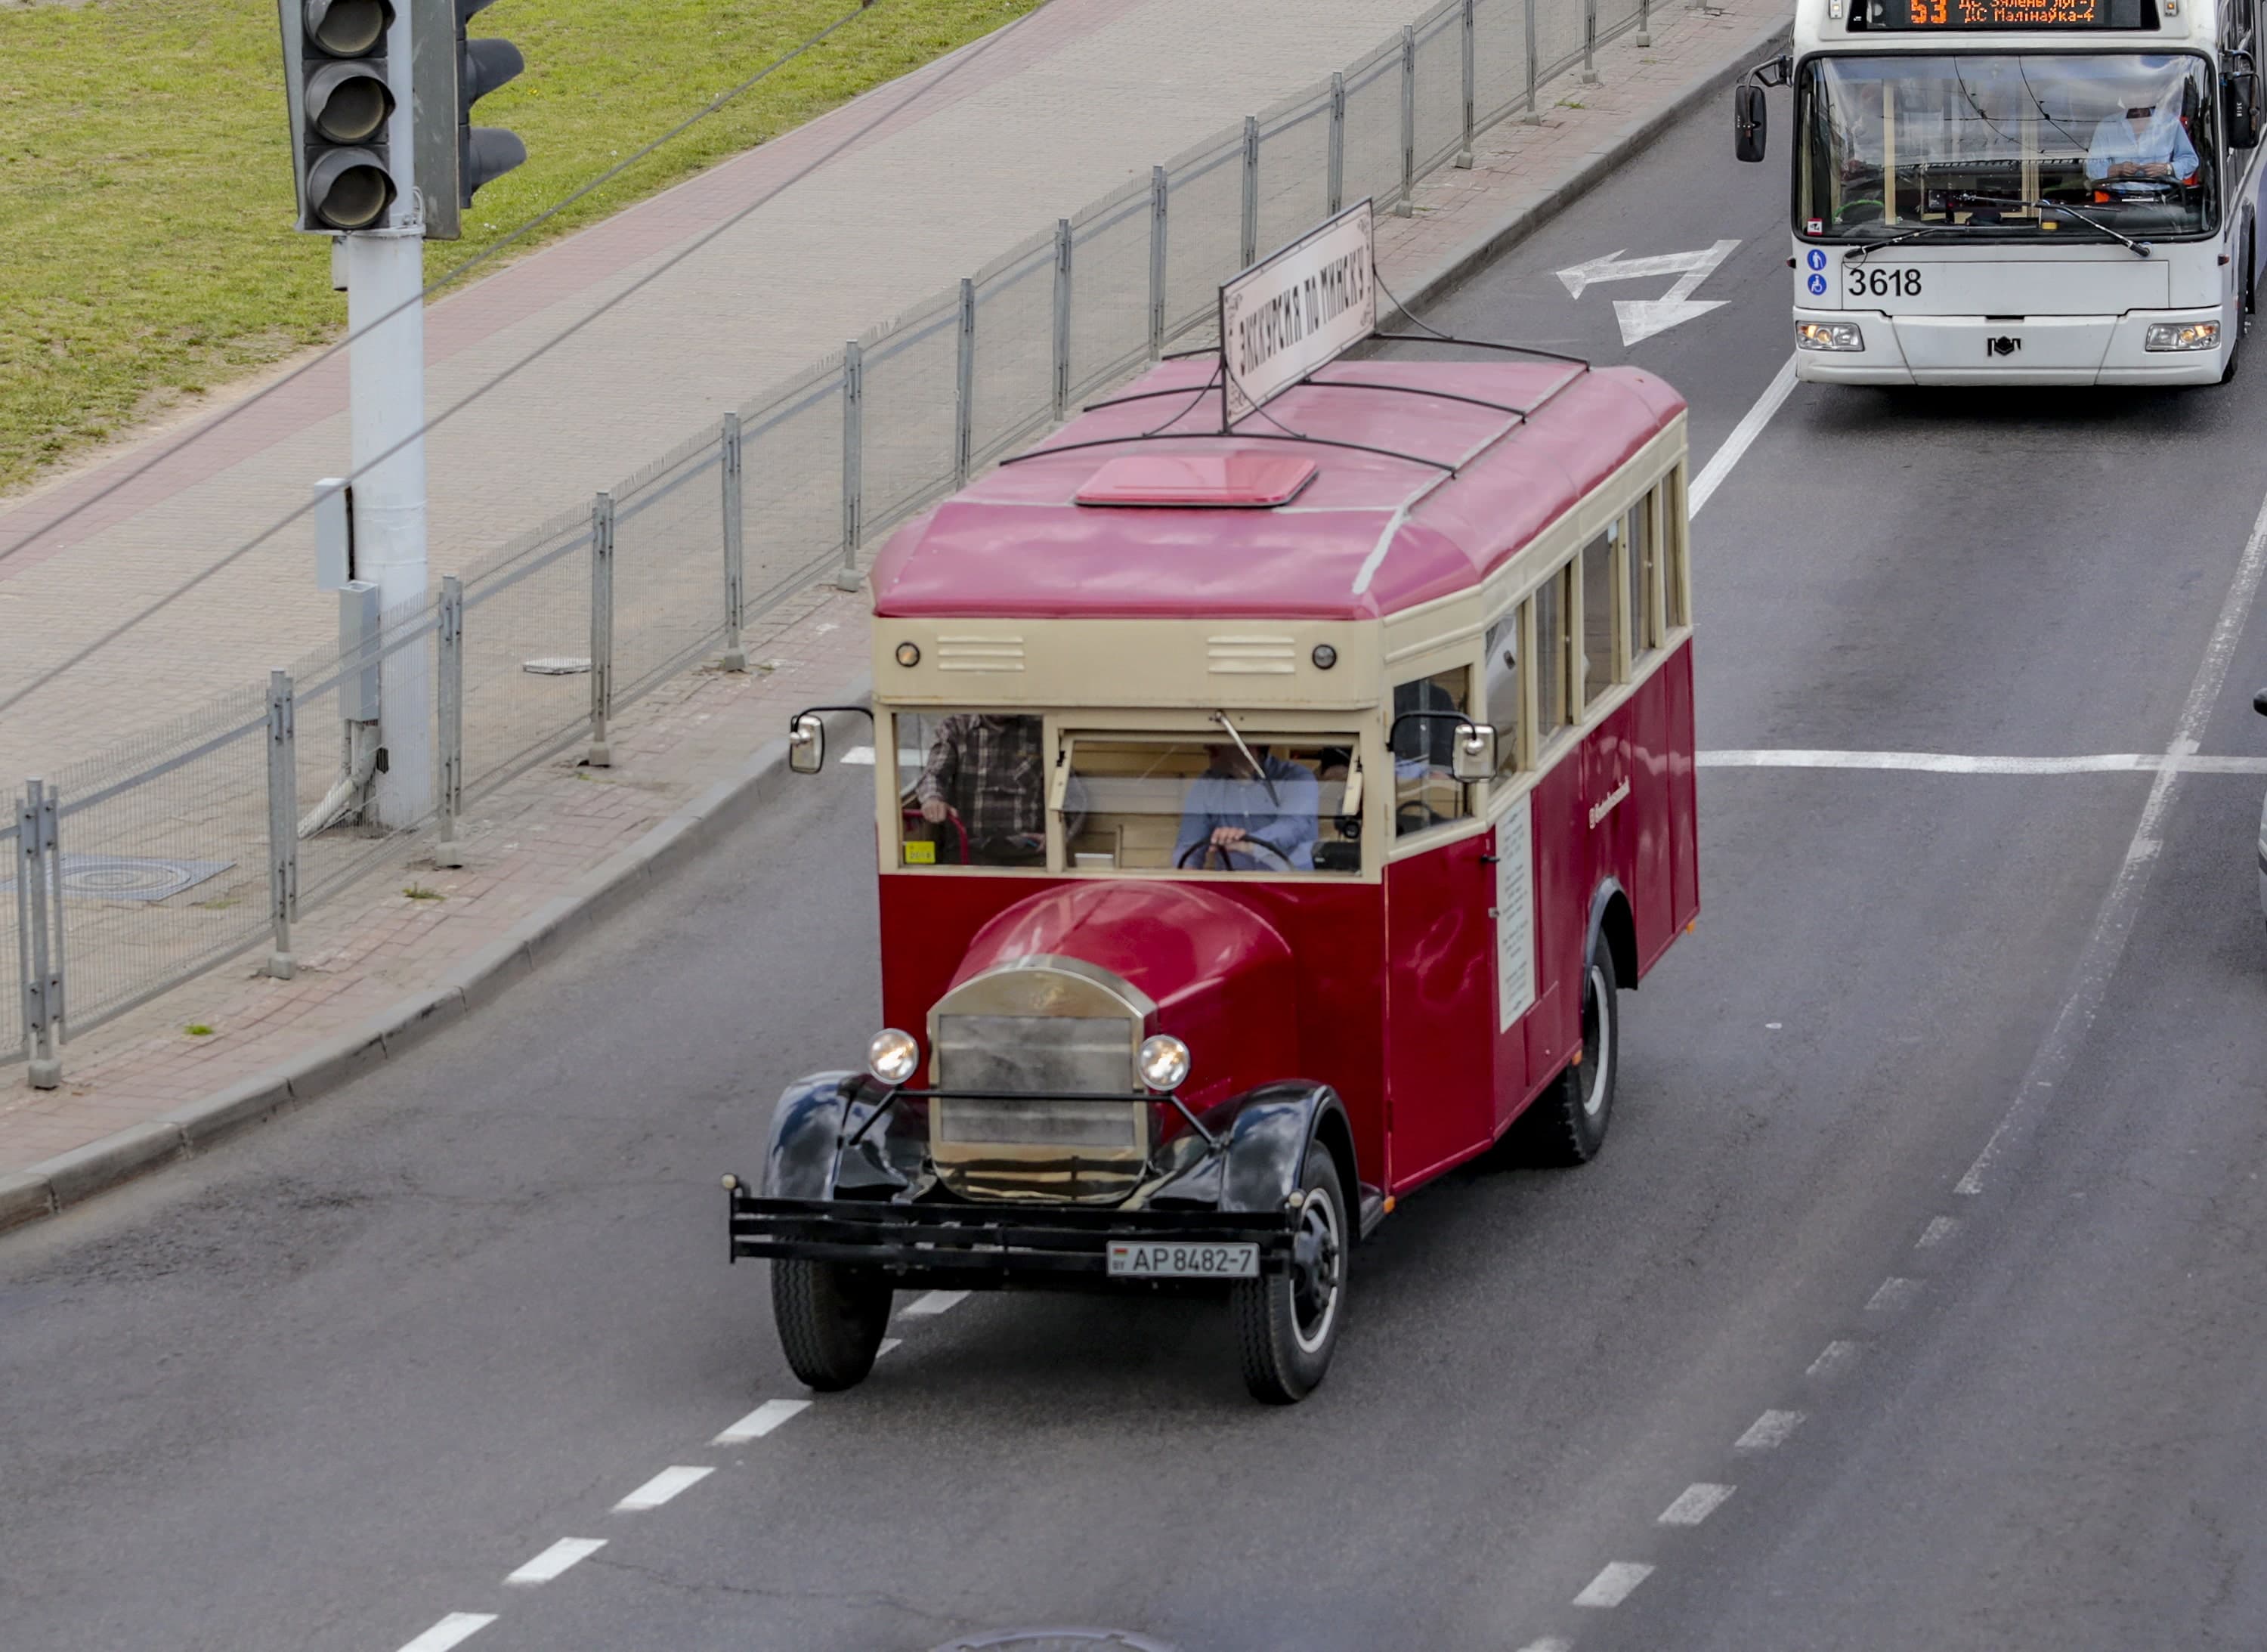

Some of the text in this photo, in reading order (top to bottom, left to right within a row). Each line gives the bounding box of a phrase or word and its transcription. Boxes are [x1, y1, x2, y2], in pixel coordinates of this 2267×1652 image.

[1911, 0, 1947, 23] 53
[1965, 8, 2094, 23] ДС Малінаўка-4
[1848, 268, 1922, 296] 3618
[1240, 246, 1364, 376] ЭКСКУРСИЯ ПО МИНСКУ
